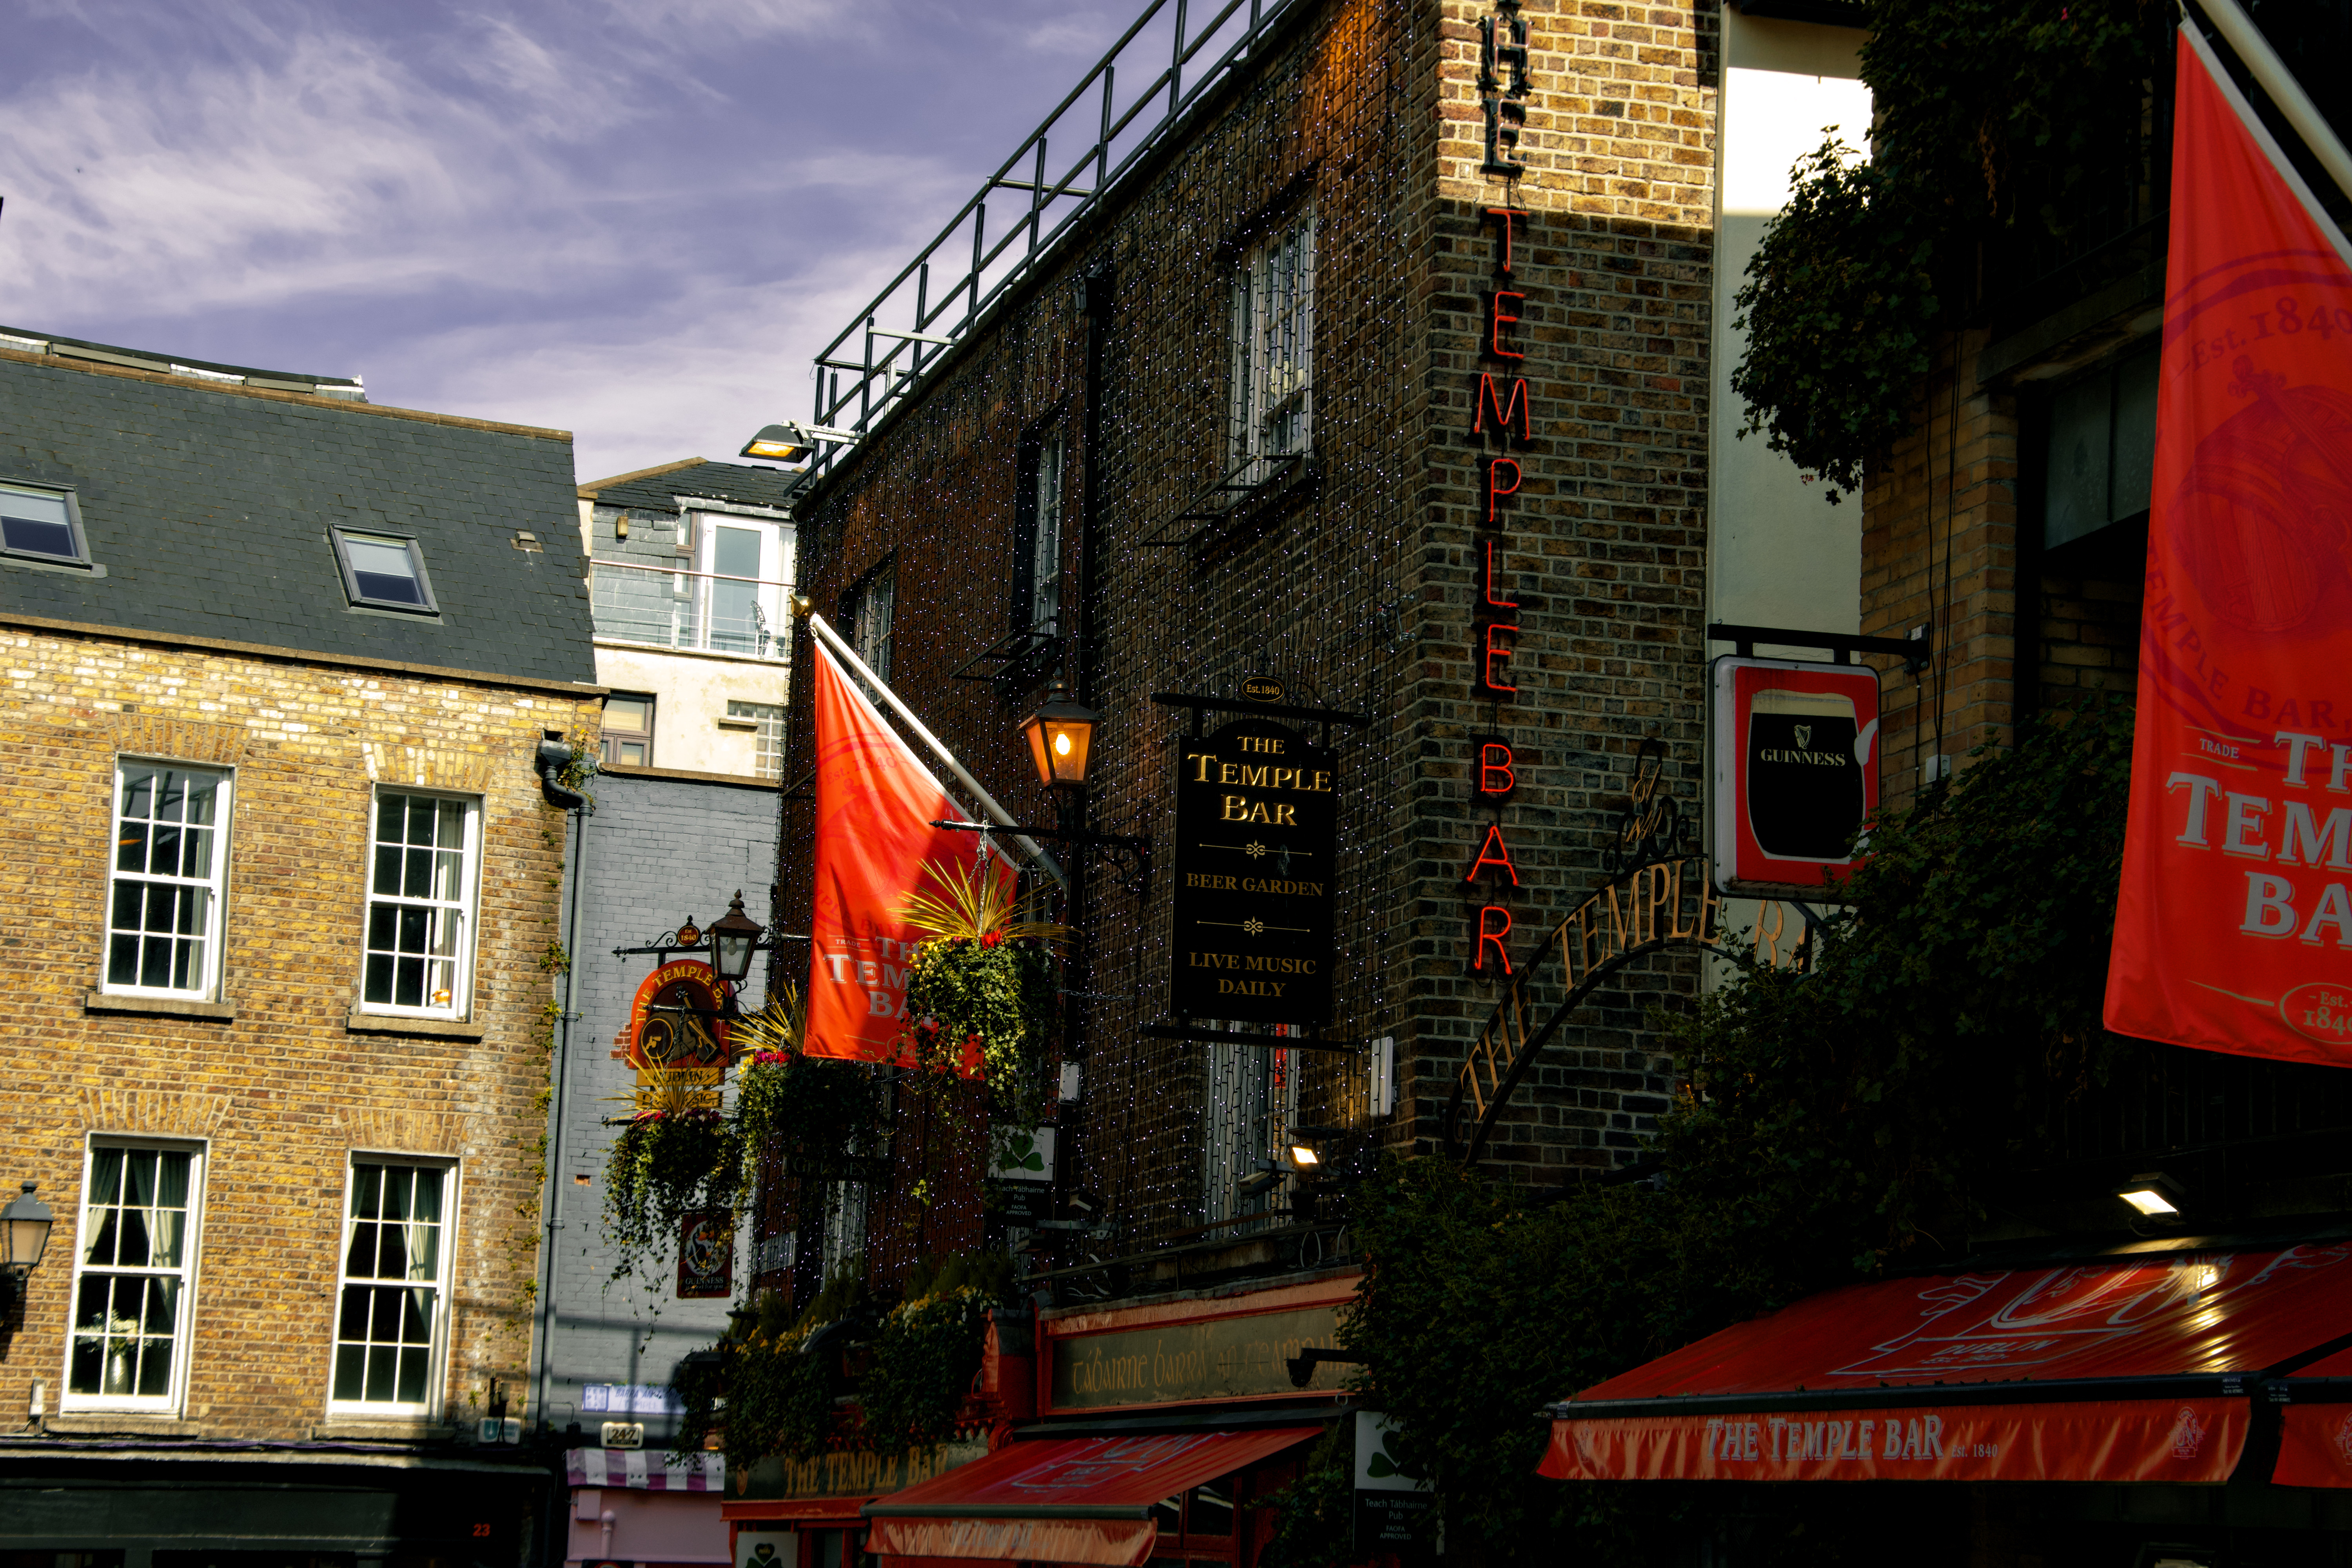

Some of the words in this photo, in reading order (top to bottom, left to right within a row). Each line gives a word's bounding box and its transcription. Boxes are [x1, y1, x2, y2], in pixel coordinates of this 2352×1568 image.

[1478, 0, 1534, 171] HE
[2191, 327, 2247, 372] Est.
[1464, 207, 1534, 693] TEMPLE
[1236, 735, 1285, 755] THE
[1760, 748, 1846, 767] GUINNESS
[2199, 737, 2240, 759] TRADE
[1186, 752, 1332, 792] TEMPLE
[1220, 793, 1297, 826] BAR
[1455, 733, 1527, 976] BAR
[1185, 873, 1238, 890] BEER
[1242, 877, 1325, 897] GARDEN
[835, 939, 861, 948] TRADE
[875, 936, 920, 963] TH
[823, 954, 911, 991] TEM
[1189, 952, 1240, 969] LIVE
[1245, 956, 1316, 975] MUSIC
[635, 987, 655, 1025] THE
[652, 964, 713, 988] TEMPLE
[1218, 978, 1287, 997] DAILY
[1460, 965, 1537, 1123] THE
[1706, 1417, 1759, 1461] THE
[1769, 1417, 1875, 1462] TEMPLE
[1882, 1414, 1945, 1461] BAR
[1973, 1443, 1998, 1458] 1840
[785, 1455, 821, 1494] THE
[825, 1450, 899, 1492] TEMPLE
[1365, 1498, 1387, 1508] Teach
[1390, 1499, 1427, 1510] Tábhairne
[1389, 1510, 1403, 1520] Pub
[472, 1523, 491, 1537] 23
[1379, 1532, 1412, 1540] APPROVED
[1386, 1524, 1405, 1532] FAOFA
